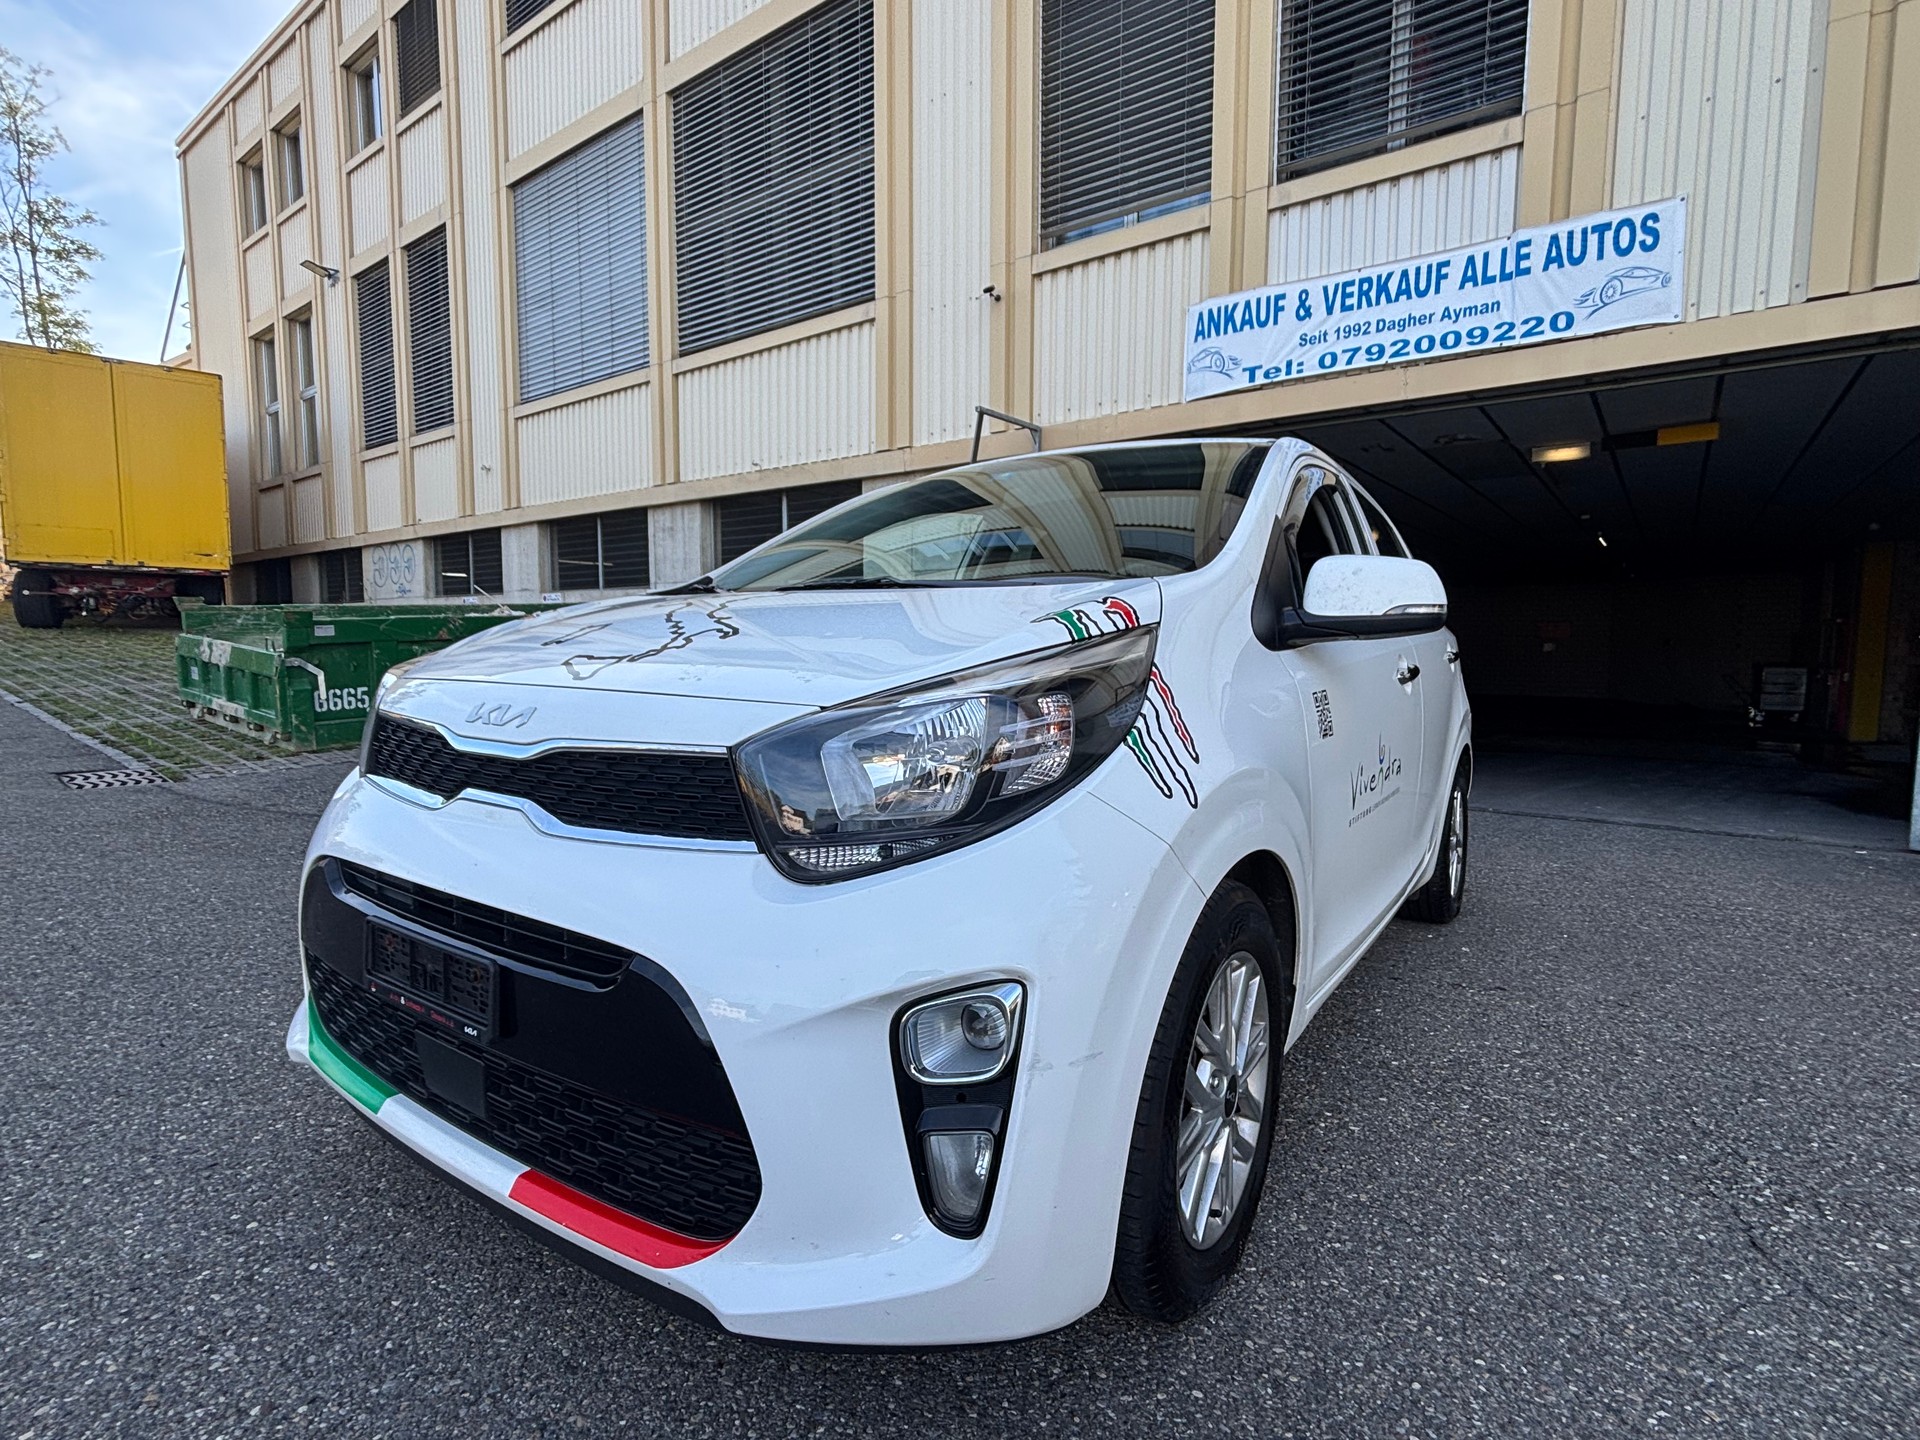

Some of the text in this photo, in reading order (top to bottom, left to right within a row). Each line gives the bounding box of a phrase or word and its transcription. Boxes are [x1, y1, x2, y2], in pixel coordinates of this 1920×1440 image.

[1193, 212, 1661, 343] ANKAUF & VERKAUF ALLE AUTOS
[1241, 311, 1576, 384] Tel: 0792009220
[1298, 300, 1501, 347] Seit 1992 Dagher Ayman
[465, 702, 537, 728] KIA
[1350, 746, 1402, 811] Vivendra
